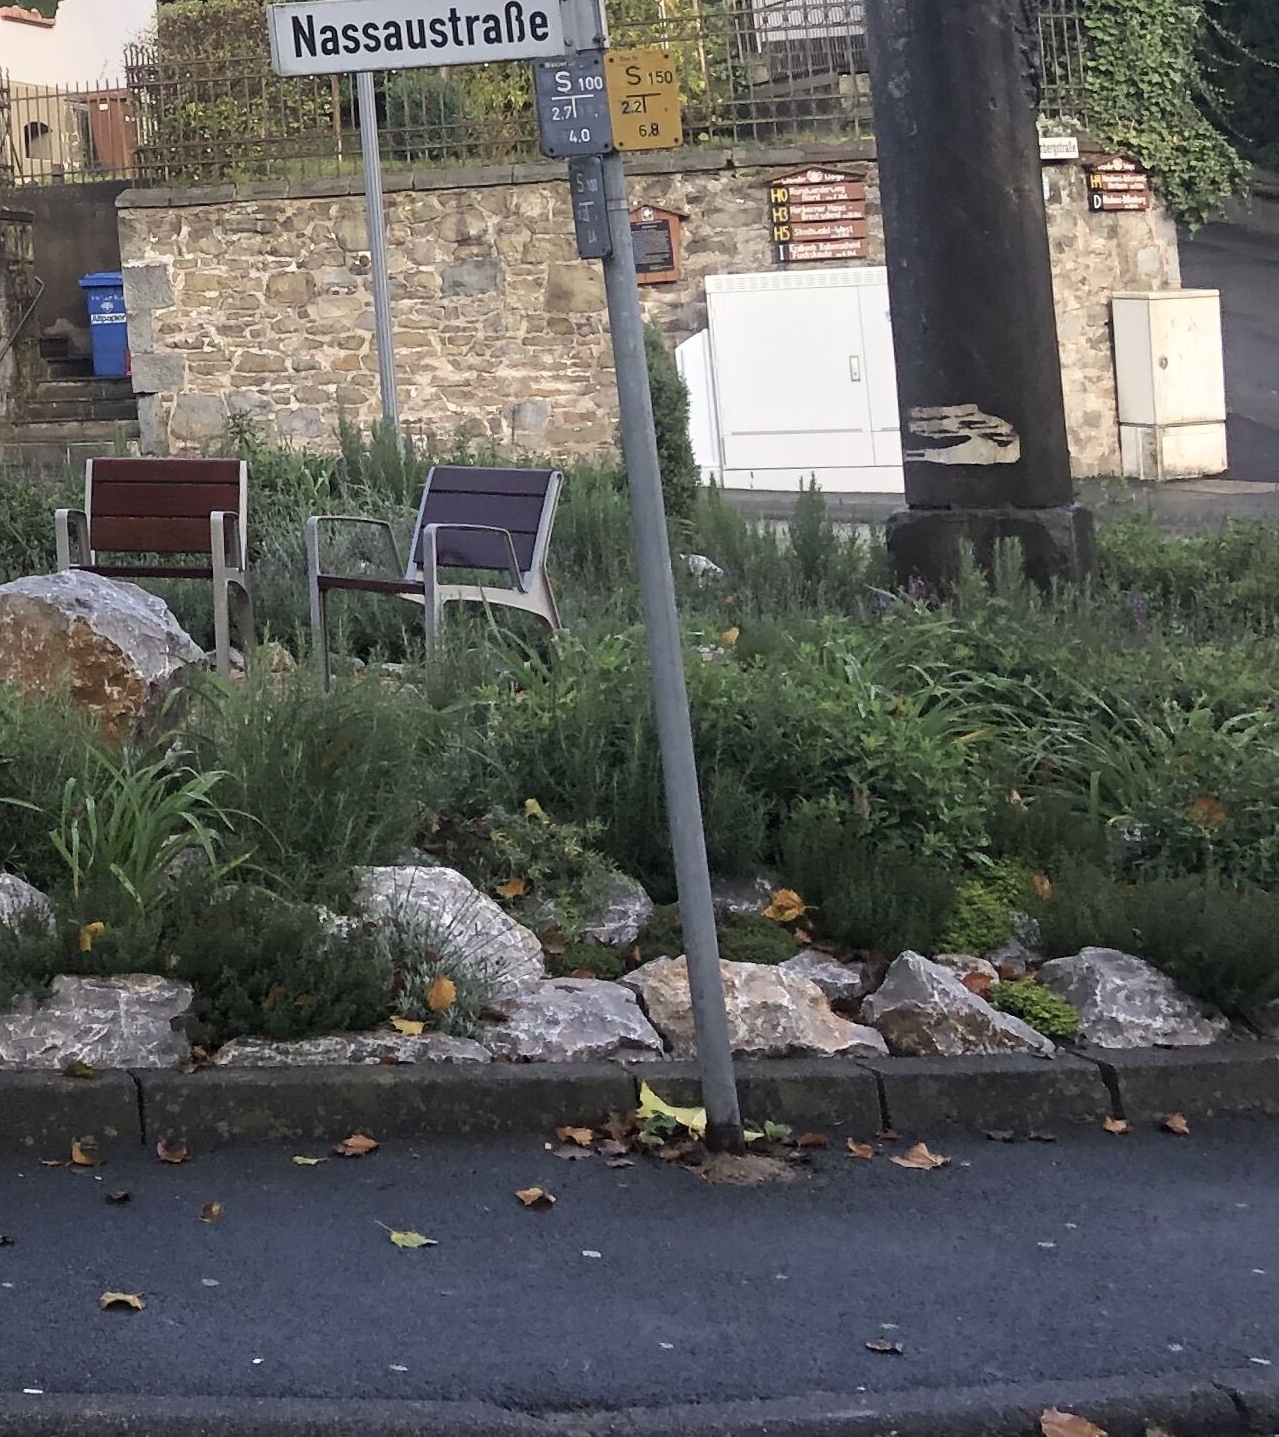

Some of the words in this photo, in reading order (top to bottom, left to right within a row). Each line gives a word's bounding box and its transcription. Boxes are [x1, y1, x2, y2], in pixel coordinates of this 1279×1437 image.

[290, 0, 550, 59] Nassaustraße
[554, 70, 572, 93] S
[578, 76, 603, 91] 100
[624, 65, 642, 86] S
[648, 70, 673, 85] 150
[551, 105, 572, 121] 2.7
[621, 100, 642, 115] 2.2
[569, 128, 591, 144] 4.0
[1040, 141, 1076, 157] bergstraße
[1093, 194, 1102, 209] D
[772, 206, 789, 223] H3
[773, 225, 791, 242] H5
